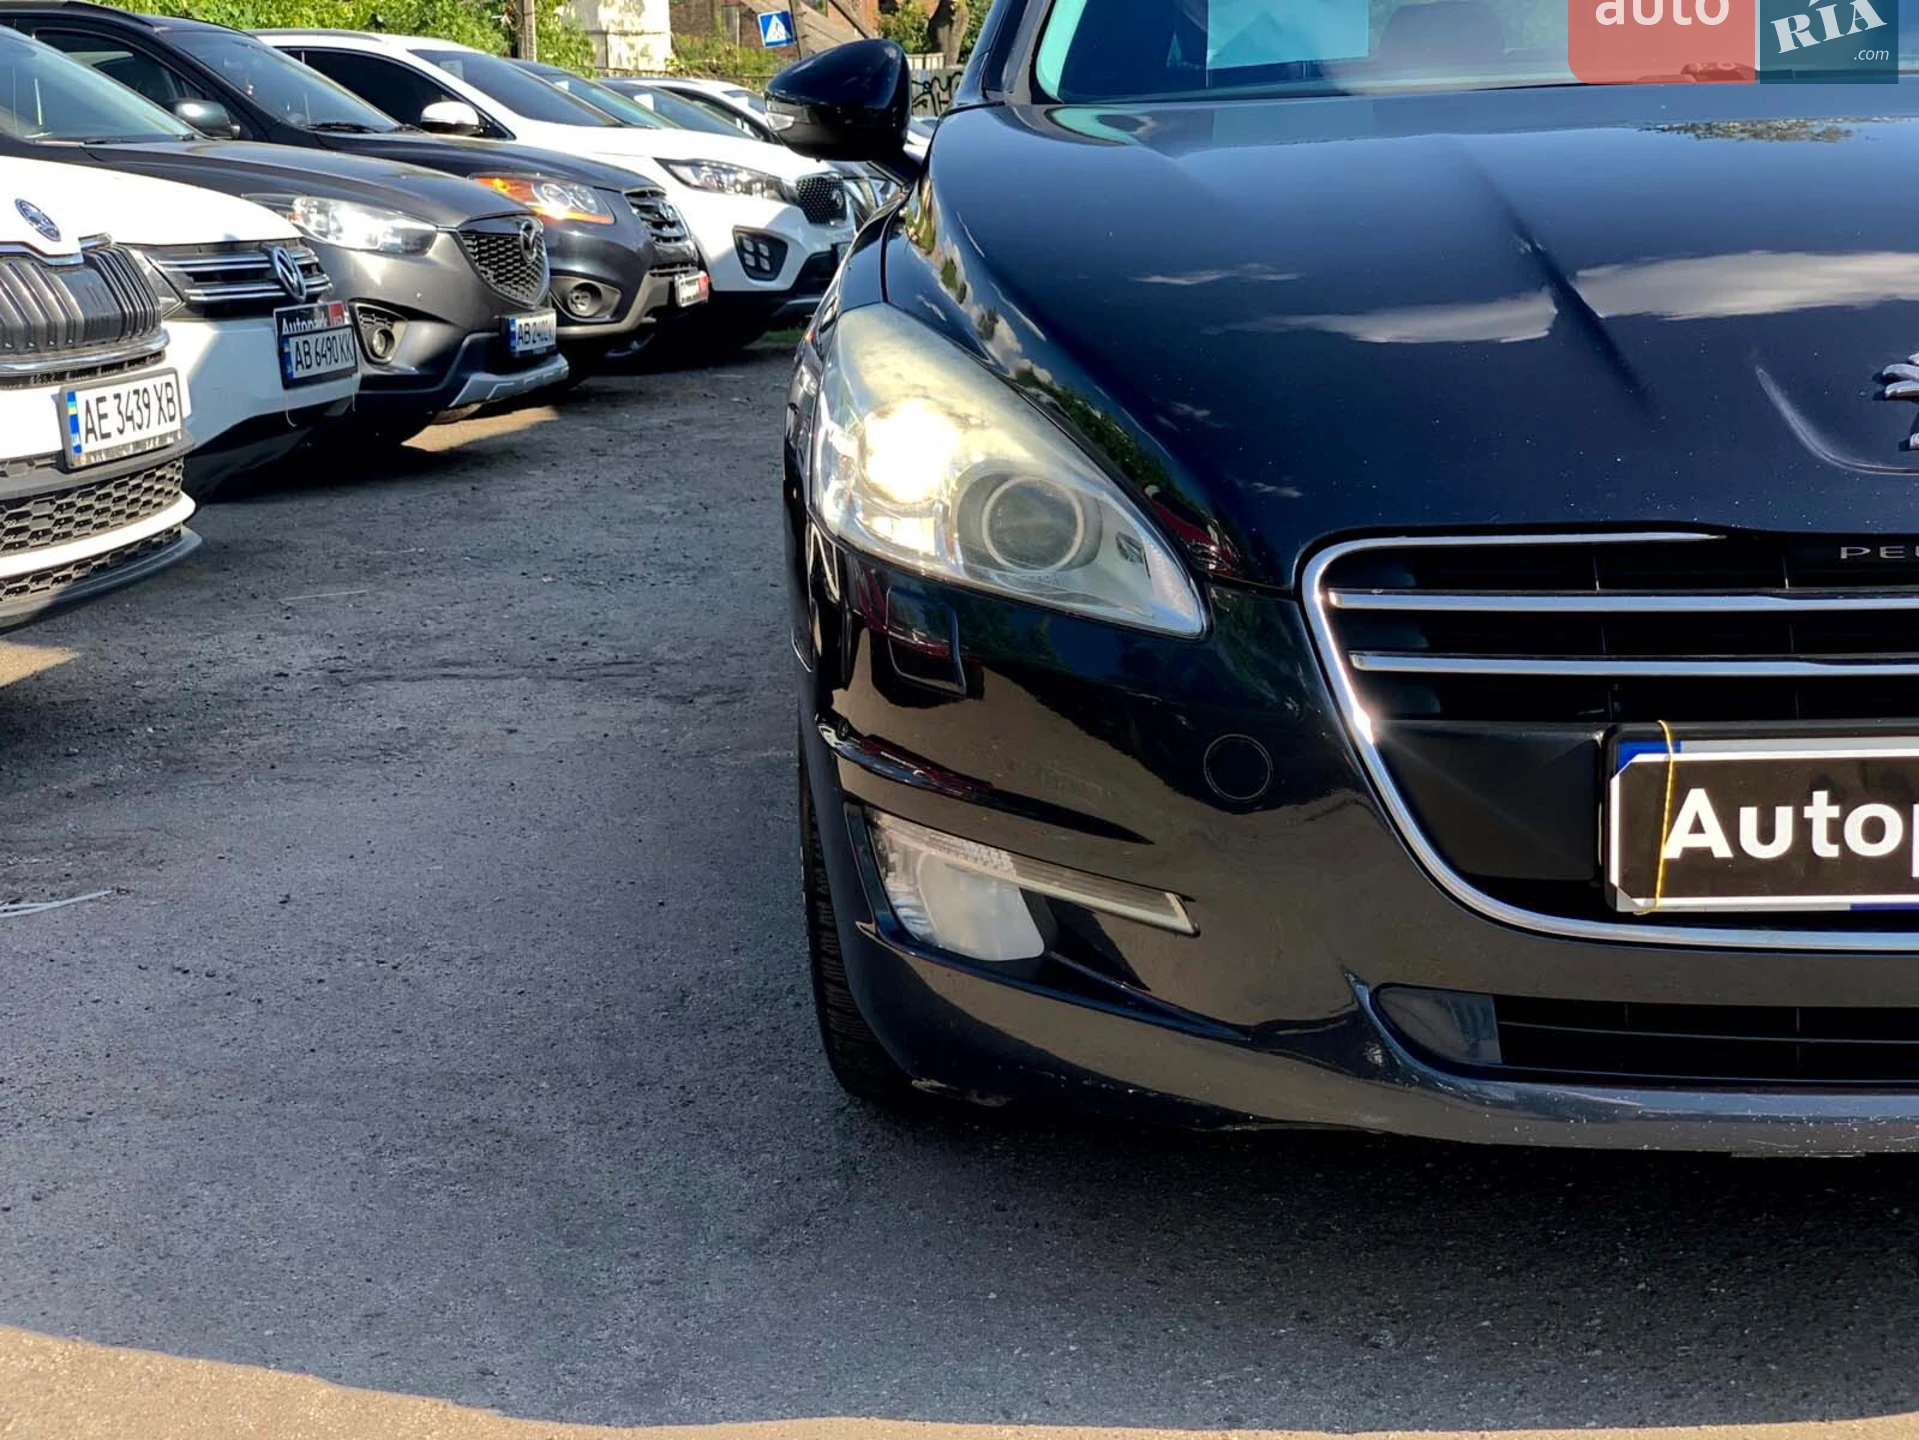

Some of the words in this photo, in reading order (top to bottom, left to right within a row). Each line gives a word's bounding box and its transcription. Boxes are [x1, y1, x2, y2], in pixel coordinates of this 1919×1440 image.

[85, 396, 112, 444] AE
[113, 387, 151, 435] 3439
[1663, 787, 1919, 878] Auto
